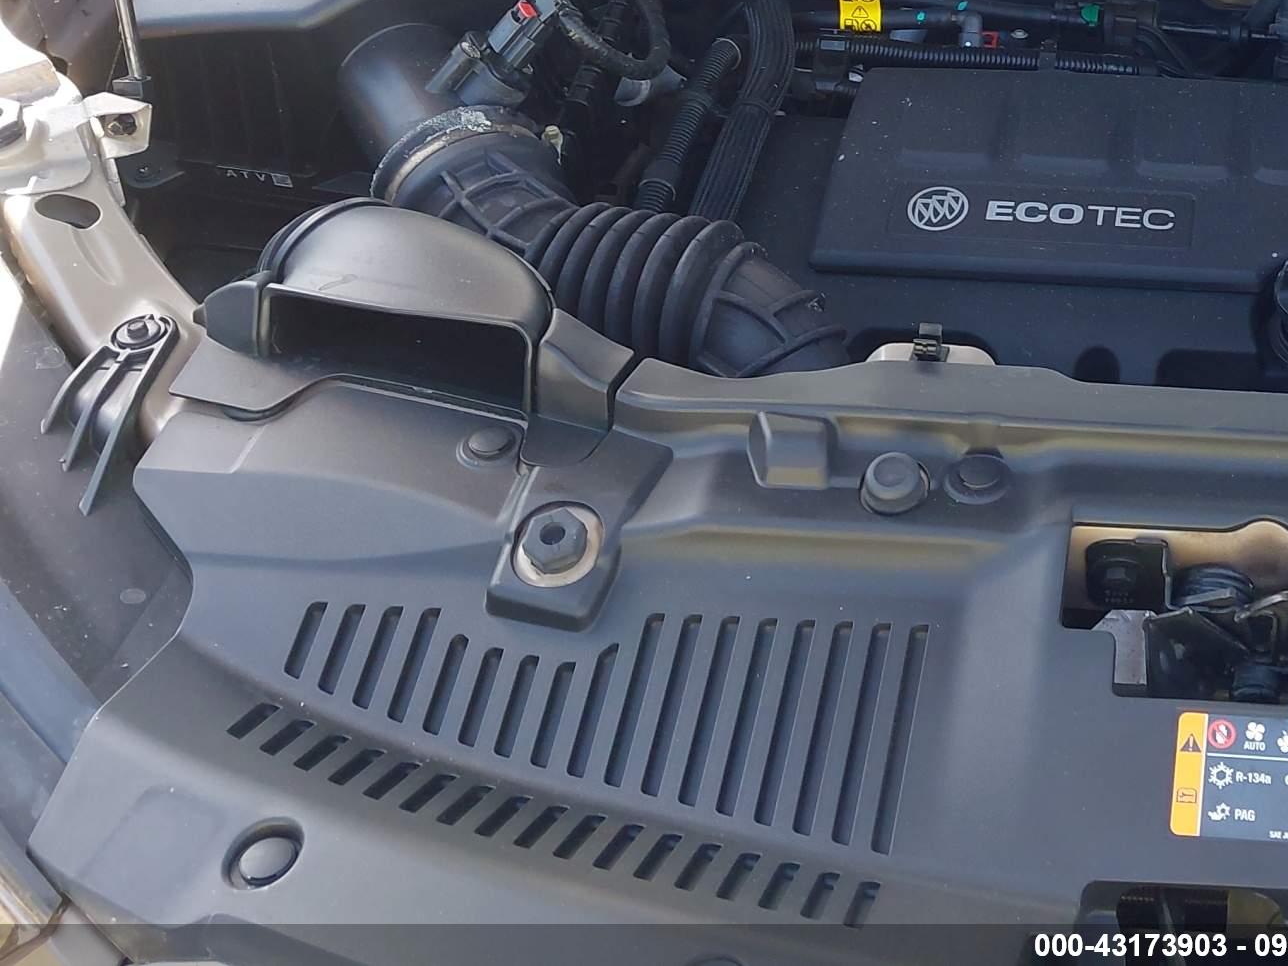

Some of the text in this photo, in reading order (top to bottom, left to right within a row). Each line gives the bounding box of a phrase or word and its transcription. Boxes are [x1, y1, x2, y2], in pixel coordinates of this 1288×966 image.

[985, 200, 1175, 230] ECOTEC
[1243, 740, 1266, 751] AUTO
[1235, 770, 1272, 785] R-134a
[1234, 808, 1256, 822] PAG
